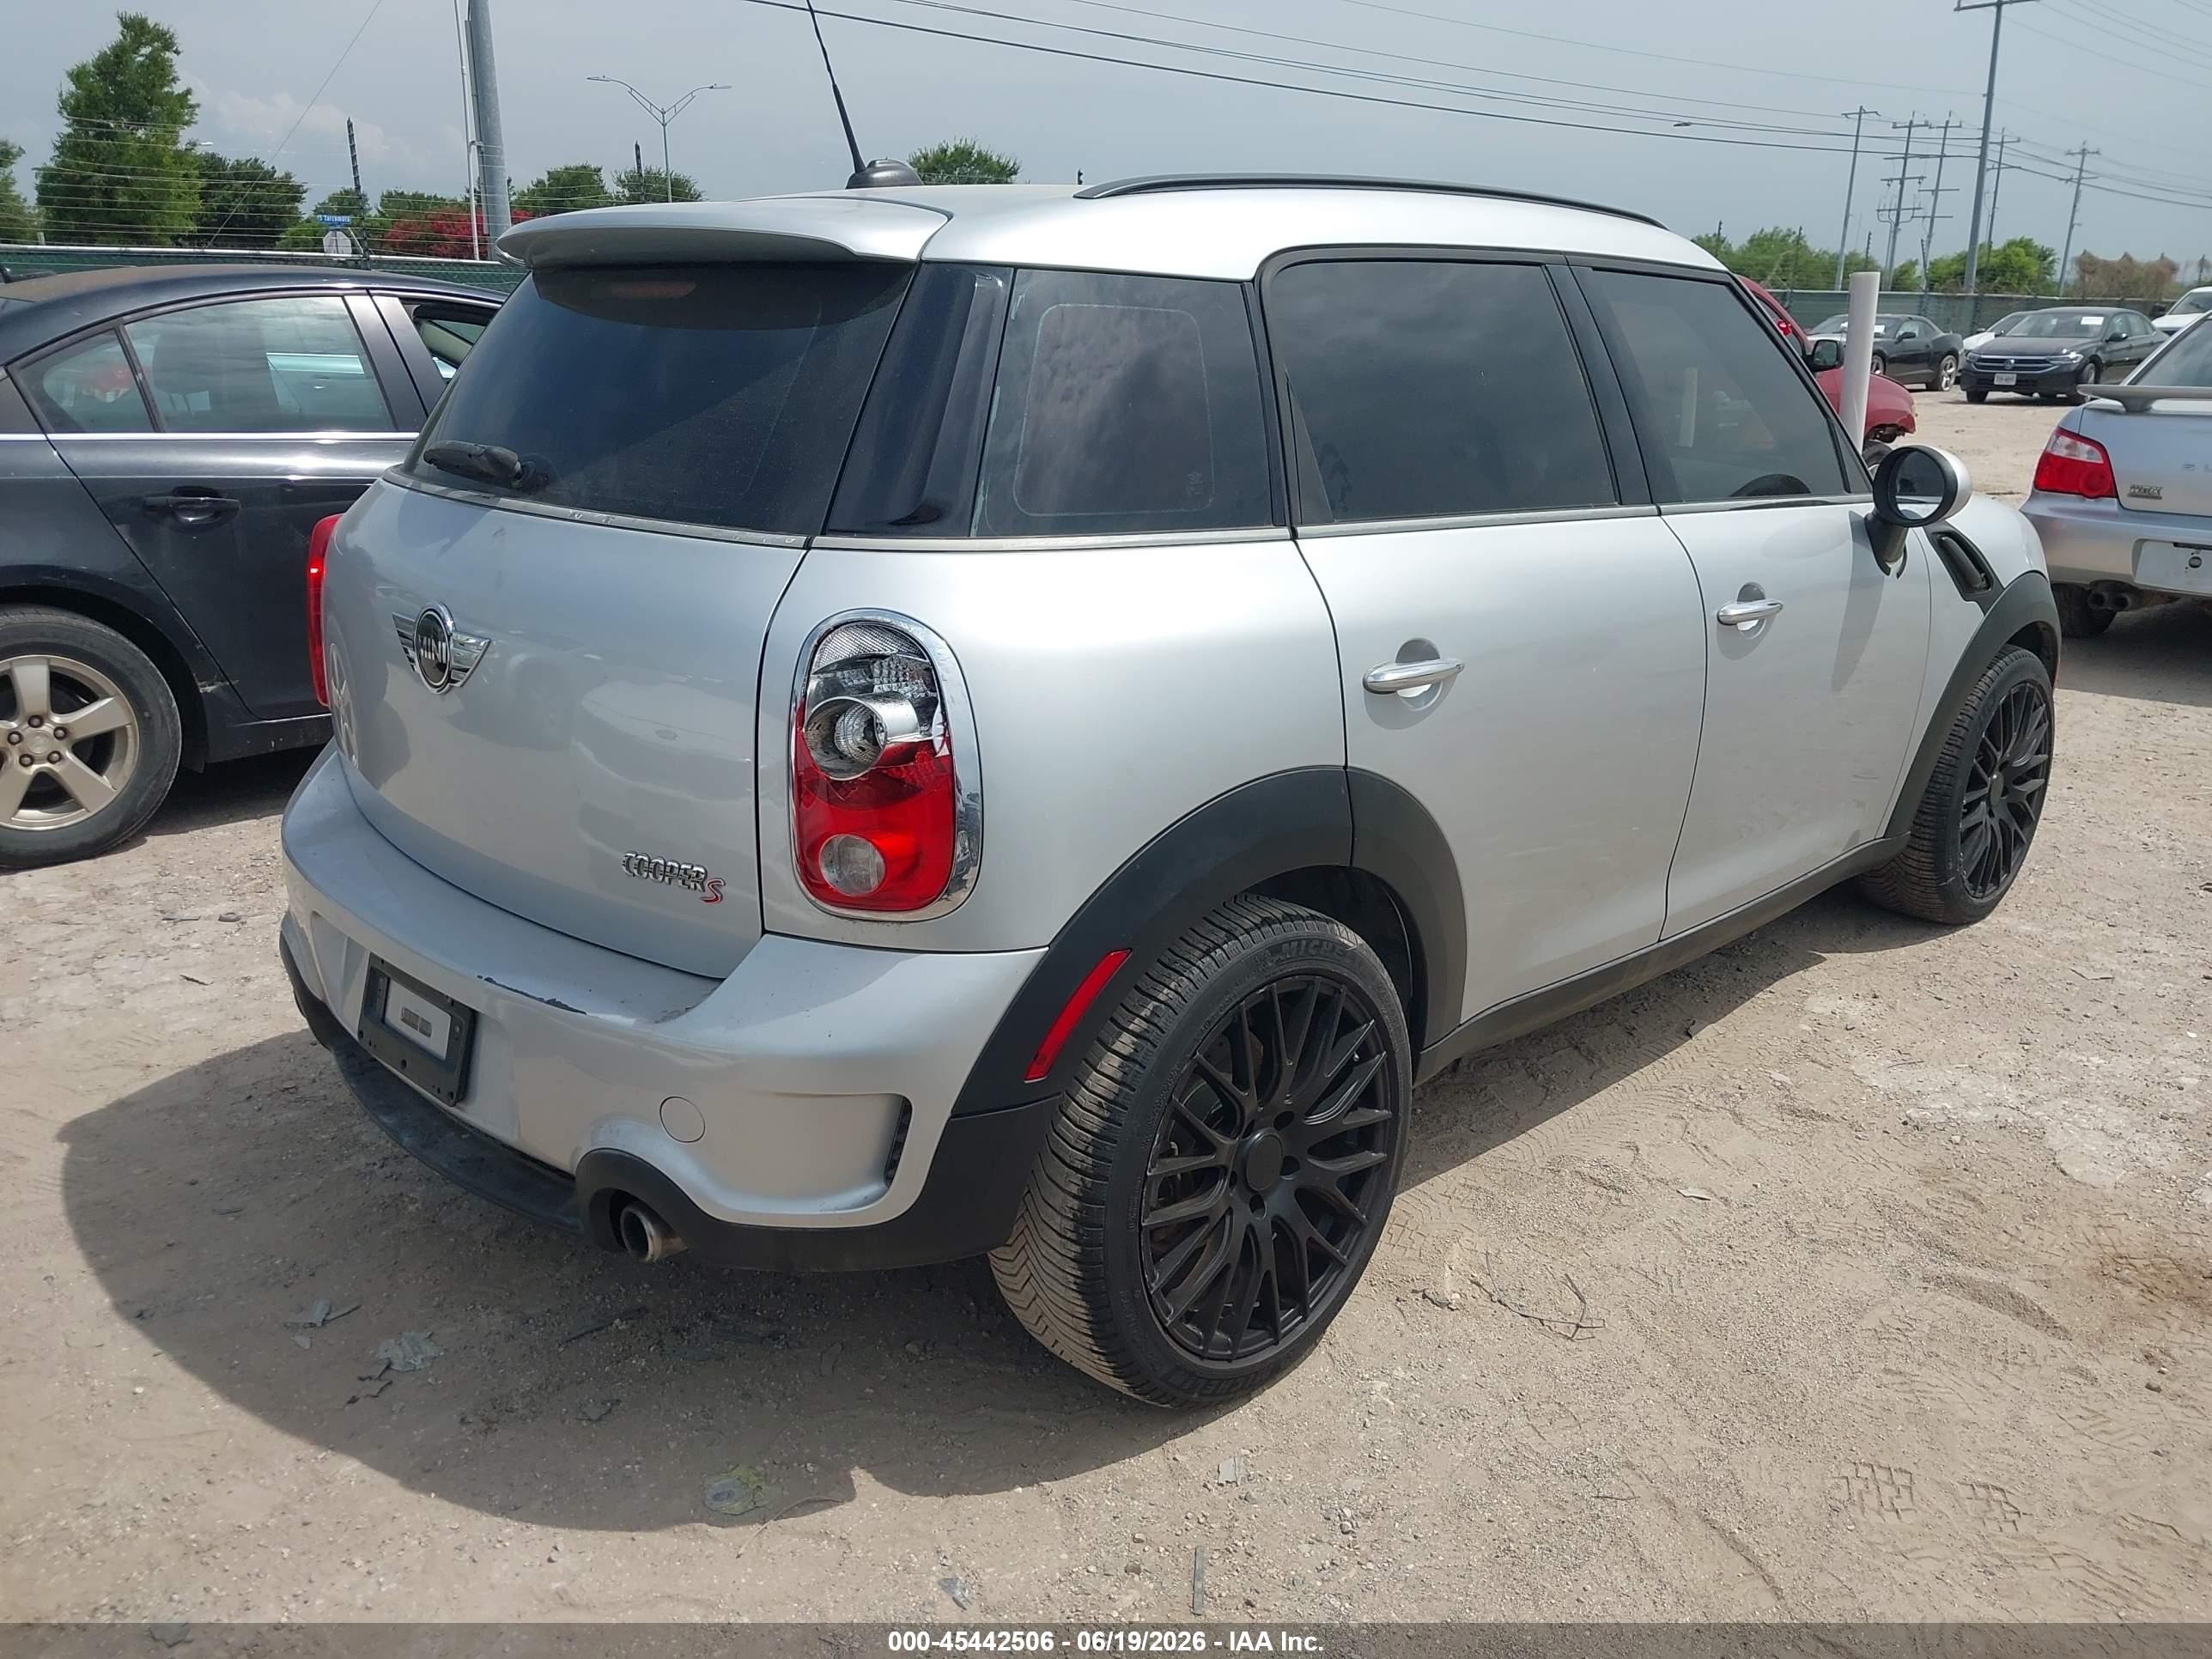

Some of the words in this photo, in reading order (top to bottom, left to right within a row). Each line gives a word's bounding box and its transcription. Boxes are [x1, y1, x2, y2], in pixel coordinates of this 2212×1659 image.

[417, 634, 447, 665] MINI
[622, 850, 708, 893] COOPER
[699, 878, 726, 904] S
